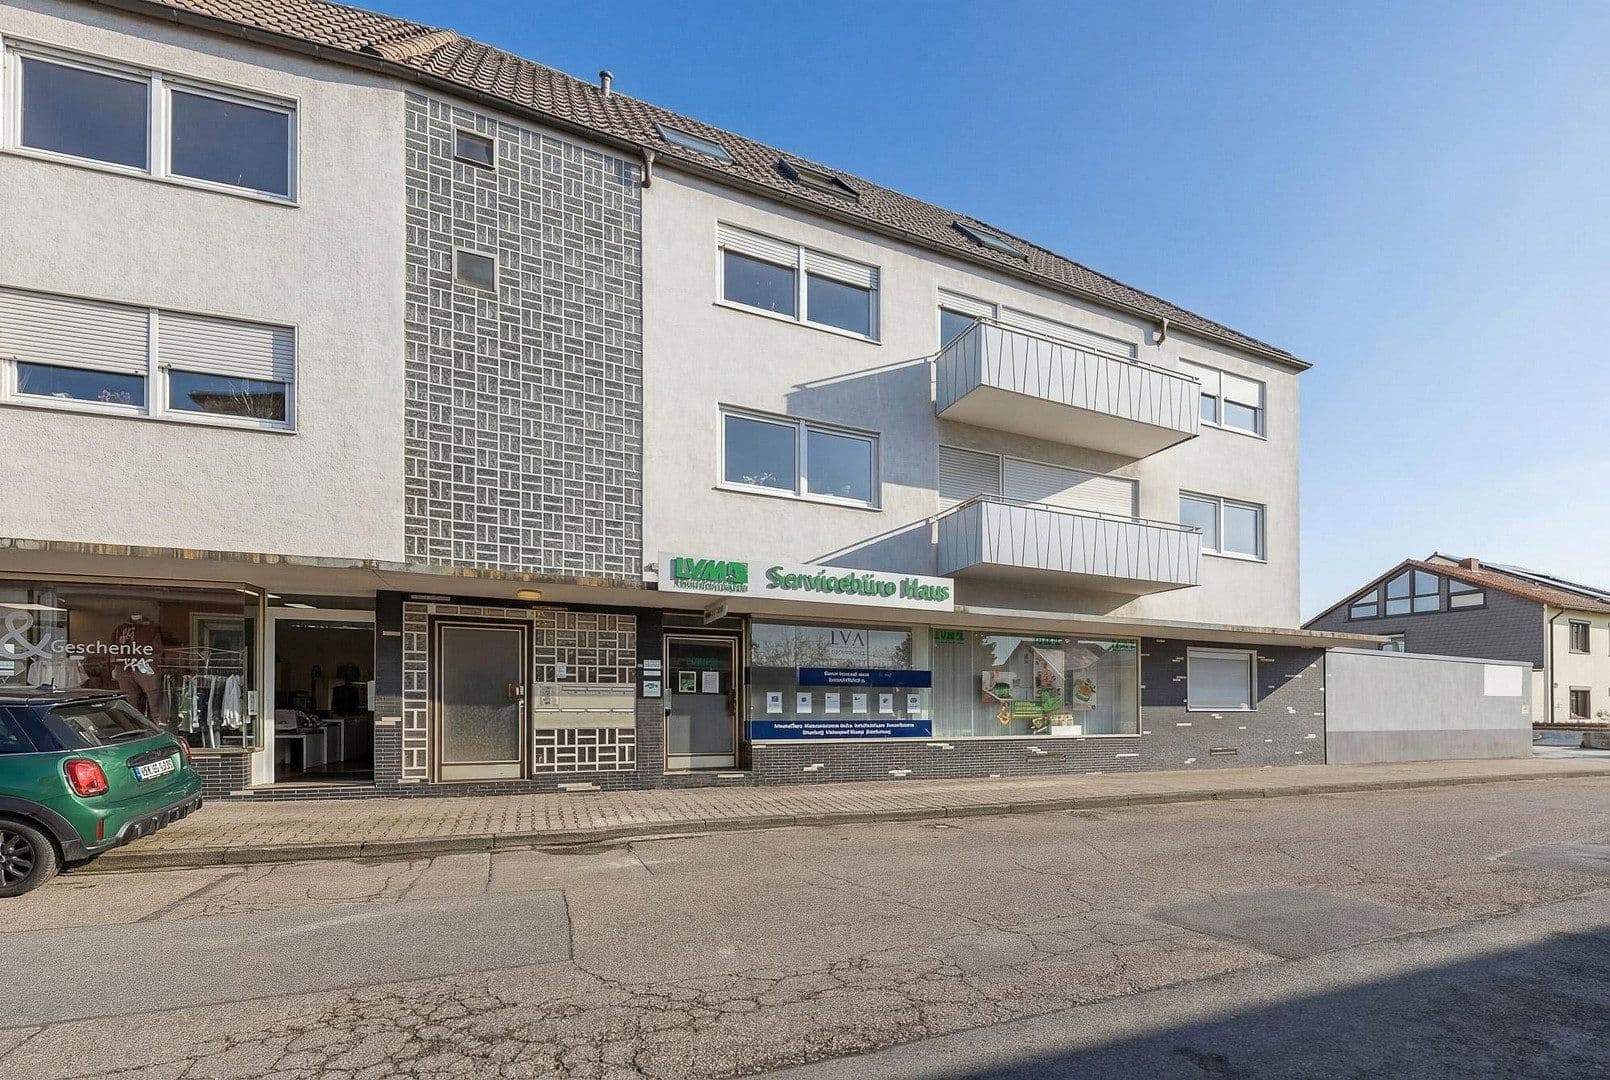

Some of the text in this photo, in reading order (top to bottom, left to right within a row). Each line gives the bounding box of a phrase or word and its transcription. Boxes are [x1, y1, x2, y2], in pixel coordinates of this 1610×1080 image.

[766, 565, 897, 597] Servicebüro
[900, 577, 950, 602] Haus
[831, 630, 864, 647] LVA
[51, 640, 154, 656] Geschenke
